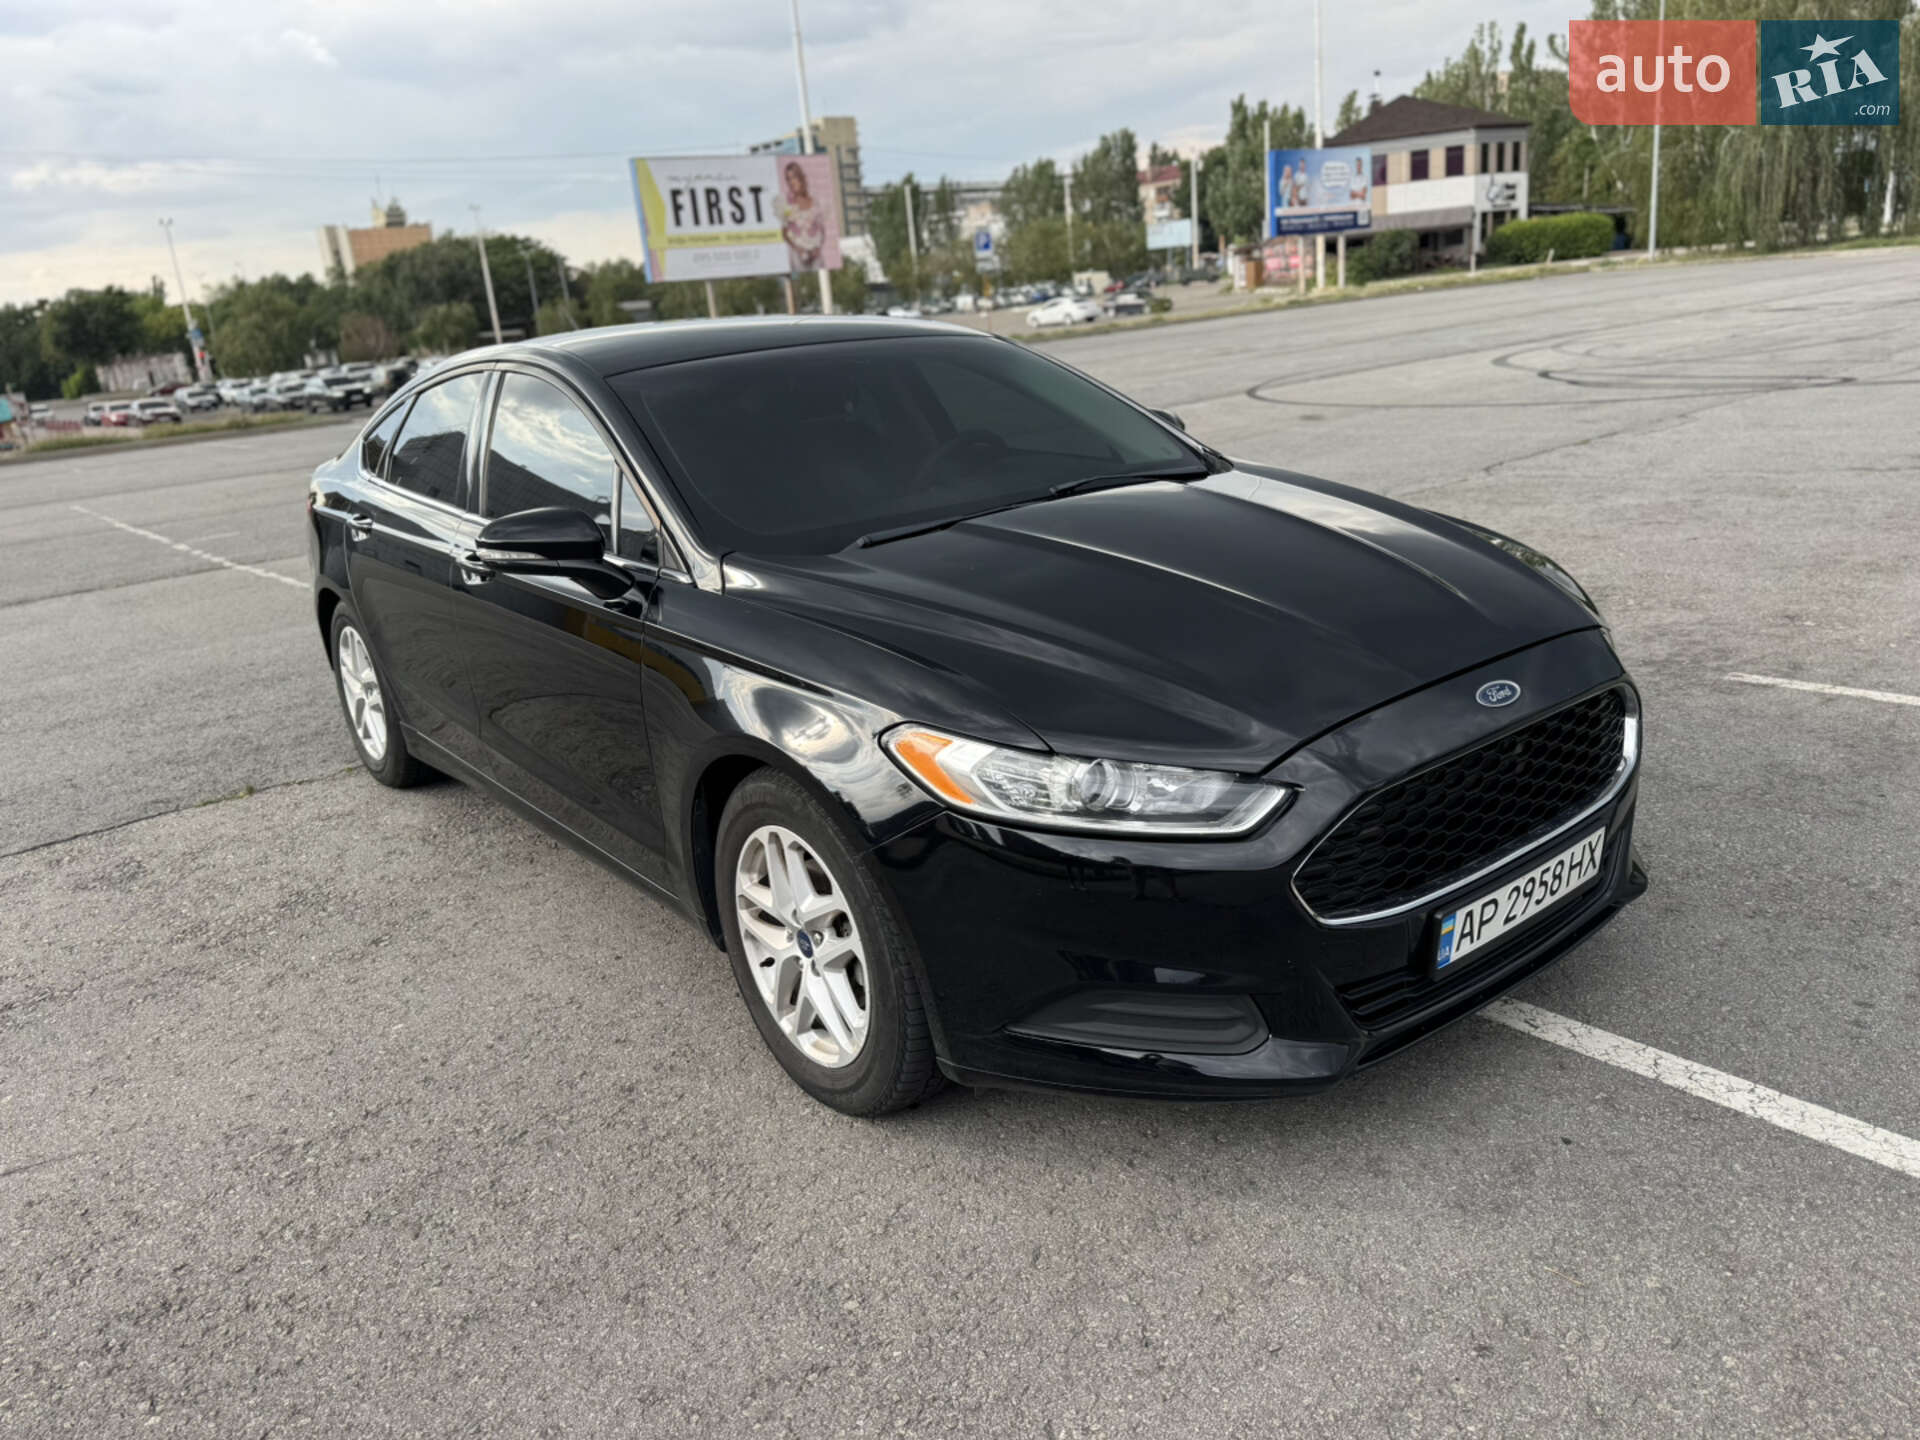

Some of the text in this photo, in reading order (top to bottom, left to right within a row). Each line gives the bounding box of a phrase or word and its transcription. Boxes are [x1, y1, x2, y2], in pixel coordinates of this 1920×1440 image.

[670, 186, 764, 227] FIRST
[1486, 685, 1512, 702] Ford
[1455, 898, 1499, 952] AP
[1502, 859, 1565, 926] 2958
